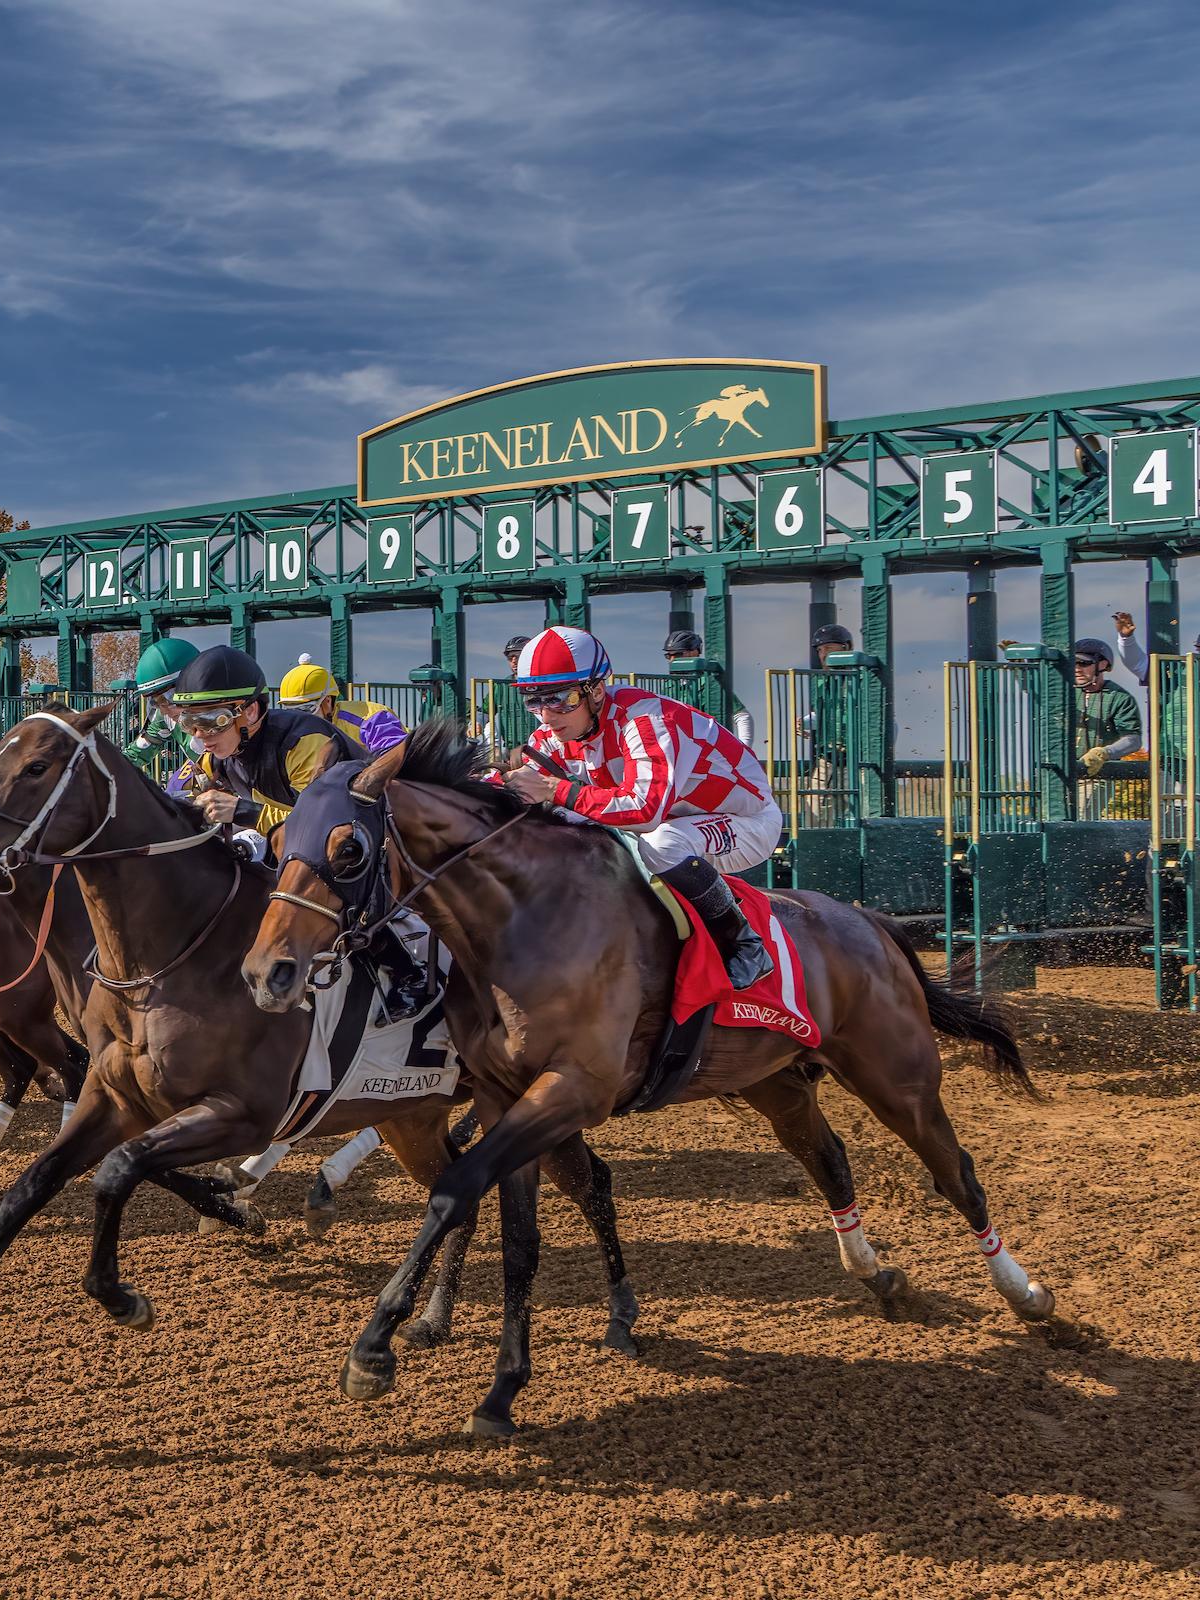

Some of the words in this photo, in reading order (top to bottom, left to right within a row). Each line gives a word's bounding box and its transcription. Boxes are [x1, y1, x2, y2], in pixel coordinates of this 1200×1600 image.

[399, 407, 668, 484] KEENELAND
[943, 470, 973, 524] 5
[1133, 449, 1173, 506] 4
[627, 502, 653, 549] 7
[774, 486, 804, 537] 6
[379, 528, 401, 570] 9
[496, 515, 520, 560] 8
[89, 560, 116, 598] 12
[176, 550, 201, 590] 11
[269, 540, 301, 582] 10
[769, 914, 808, 1022] 1
[732, 1002, 812, 1038] KEENELAND
[360, 1073, 441, 1095] KEENELAND
